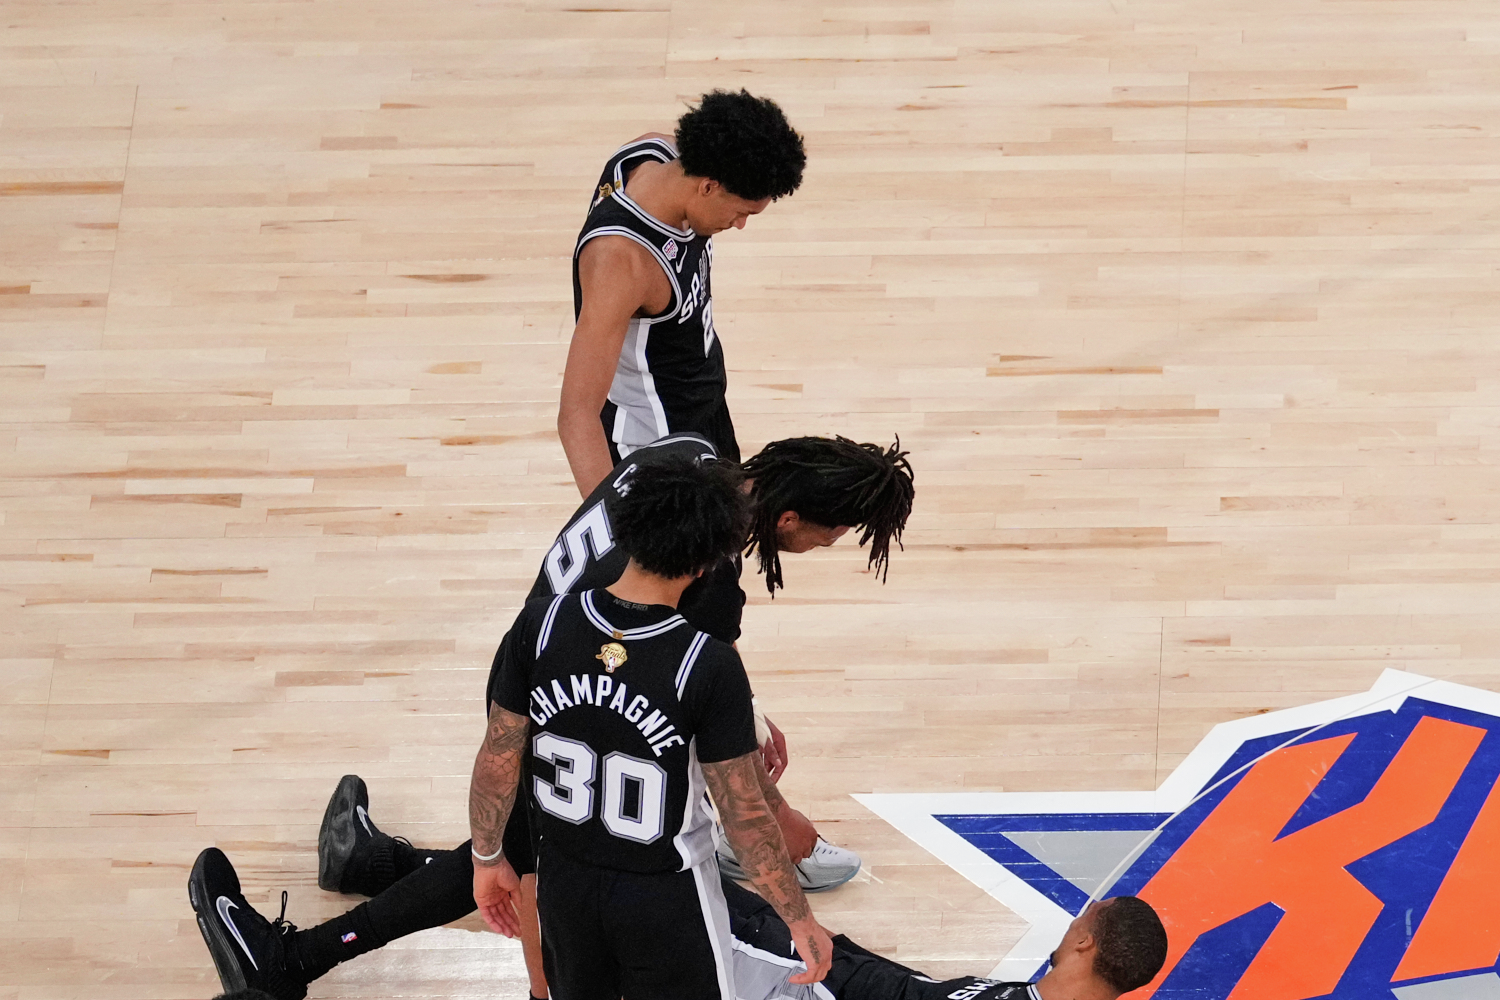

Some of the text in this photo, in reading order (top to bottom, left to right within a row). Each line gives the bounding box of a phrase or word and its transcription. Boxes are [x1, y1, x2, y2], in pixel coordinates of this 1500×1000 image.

[544, 499, 615, 594] 5
[613, 598, 649, 611] NIKE PRO
[529, 673, 685, 758] CHAMPAGNIE
[533, 731, 667, 845] 30
